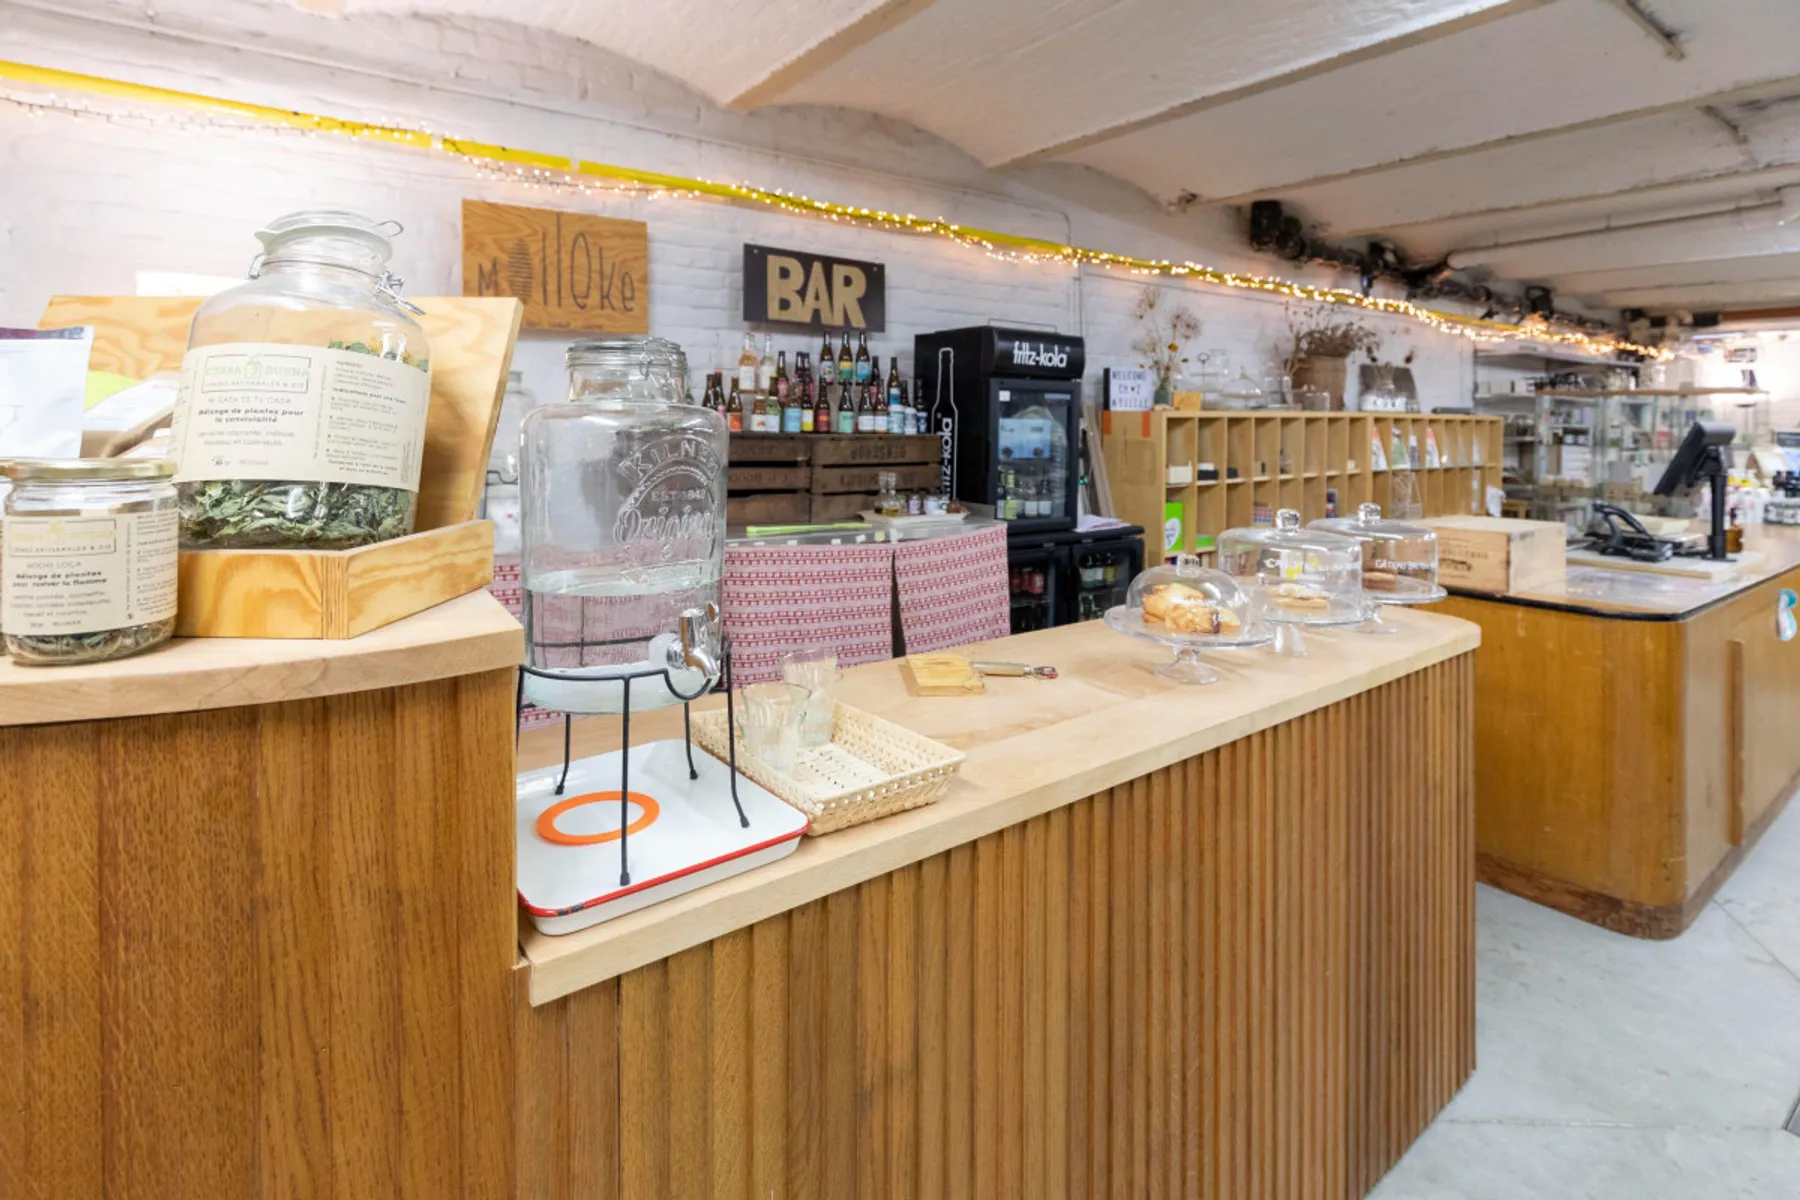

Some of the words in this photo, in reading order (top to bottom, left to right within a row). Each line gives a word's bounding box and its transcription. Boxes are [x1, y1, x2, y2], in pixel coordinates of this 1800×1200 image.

[766, 254, 867, 329] BAR
[1013, 340, 1068, 368] fritz-kola
[231, 407, 241, 415] de
[244, 407, 279, 416] plantes
[651, 490, 677, 501] EST
[16, 572, 48, 580] Mélange
[65, 571, 102, 579] plantes
